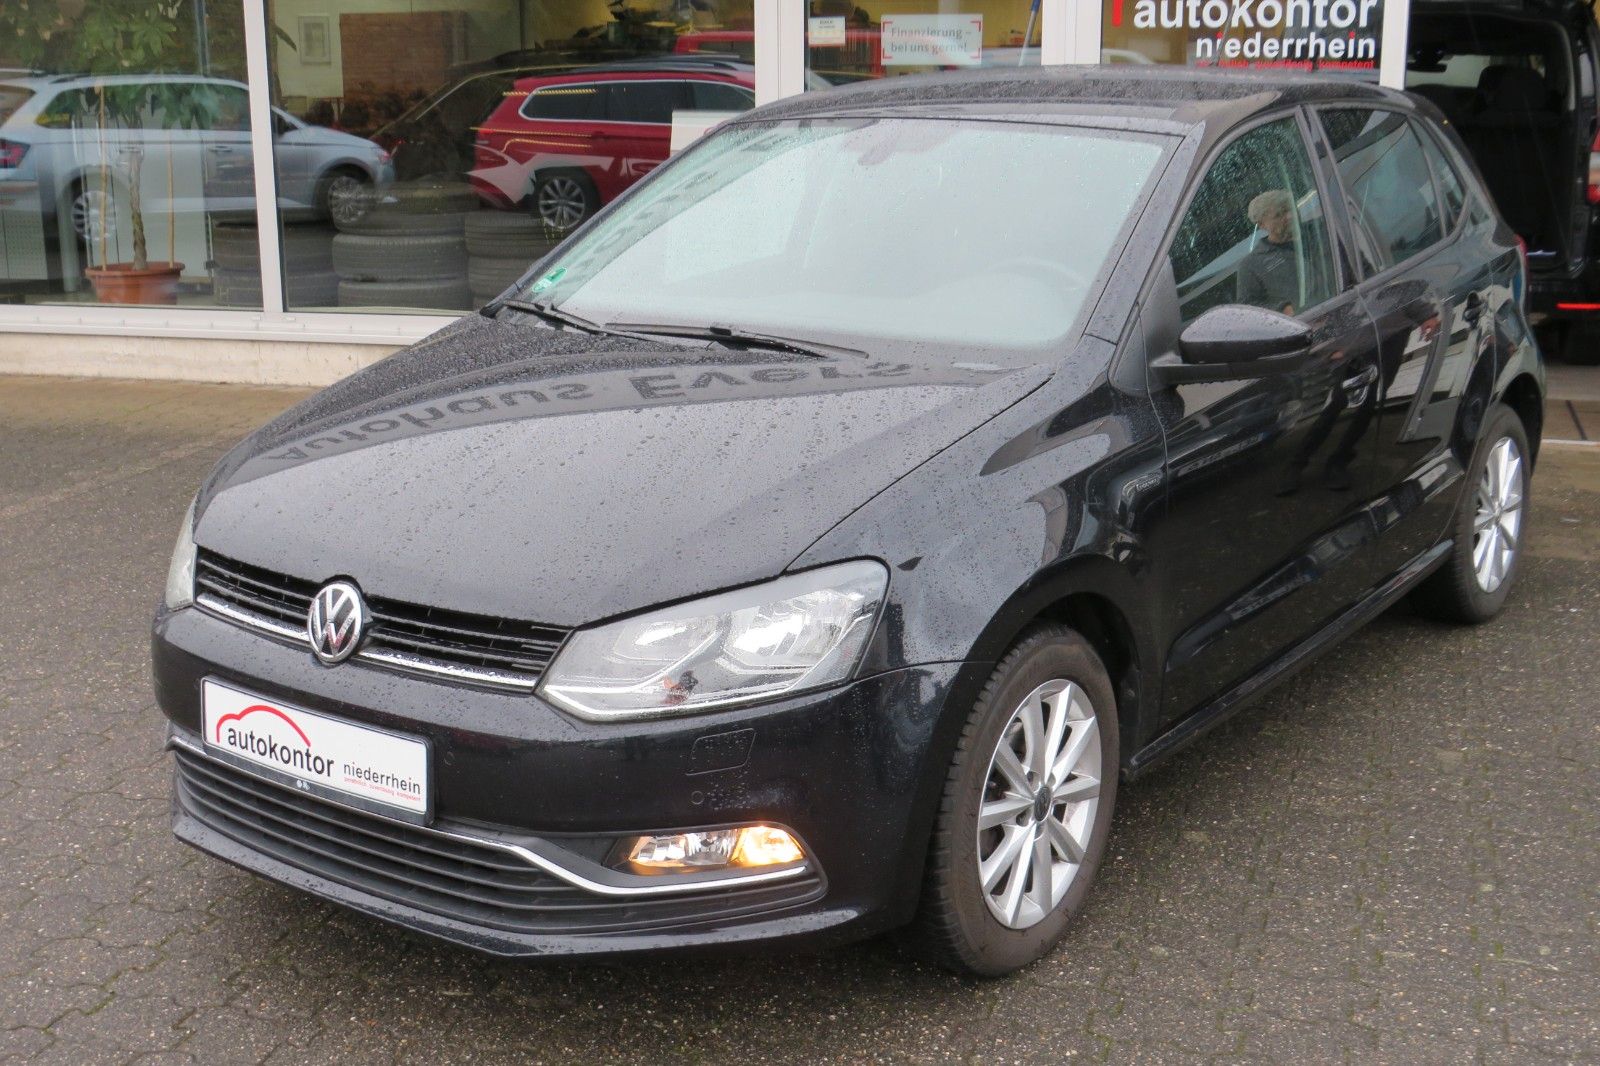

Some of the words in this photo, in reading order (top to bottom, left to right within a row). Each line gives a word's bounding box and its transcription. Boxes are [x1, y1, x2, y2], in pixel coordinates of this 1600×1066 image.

[1133, 0, 1378, 29] autokontor
[890, 26, 962, 40] Finanzierung
[890, 42, 907, 53] bei
[910, 44, 929, 53] uns
[1196, 31, 1376, 60] niederrhein
[228, 727, 335, 777] autokontor
[343, 761, 421, 795] niederrhein
